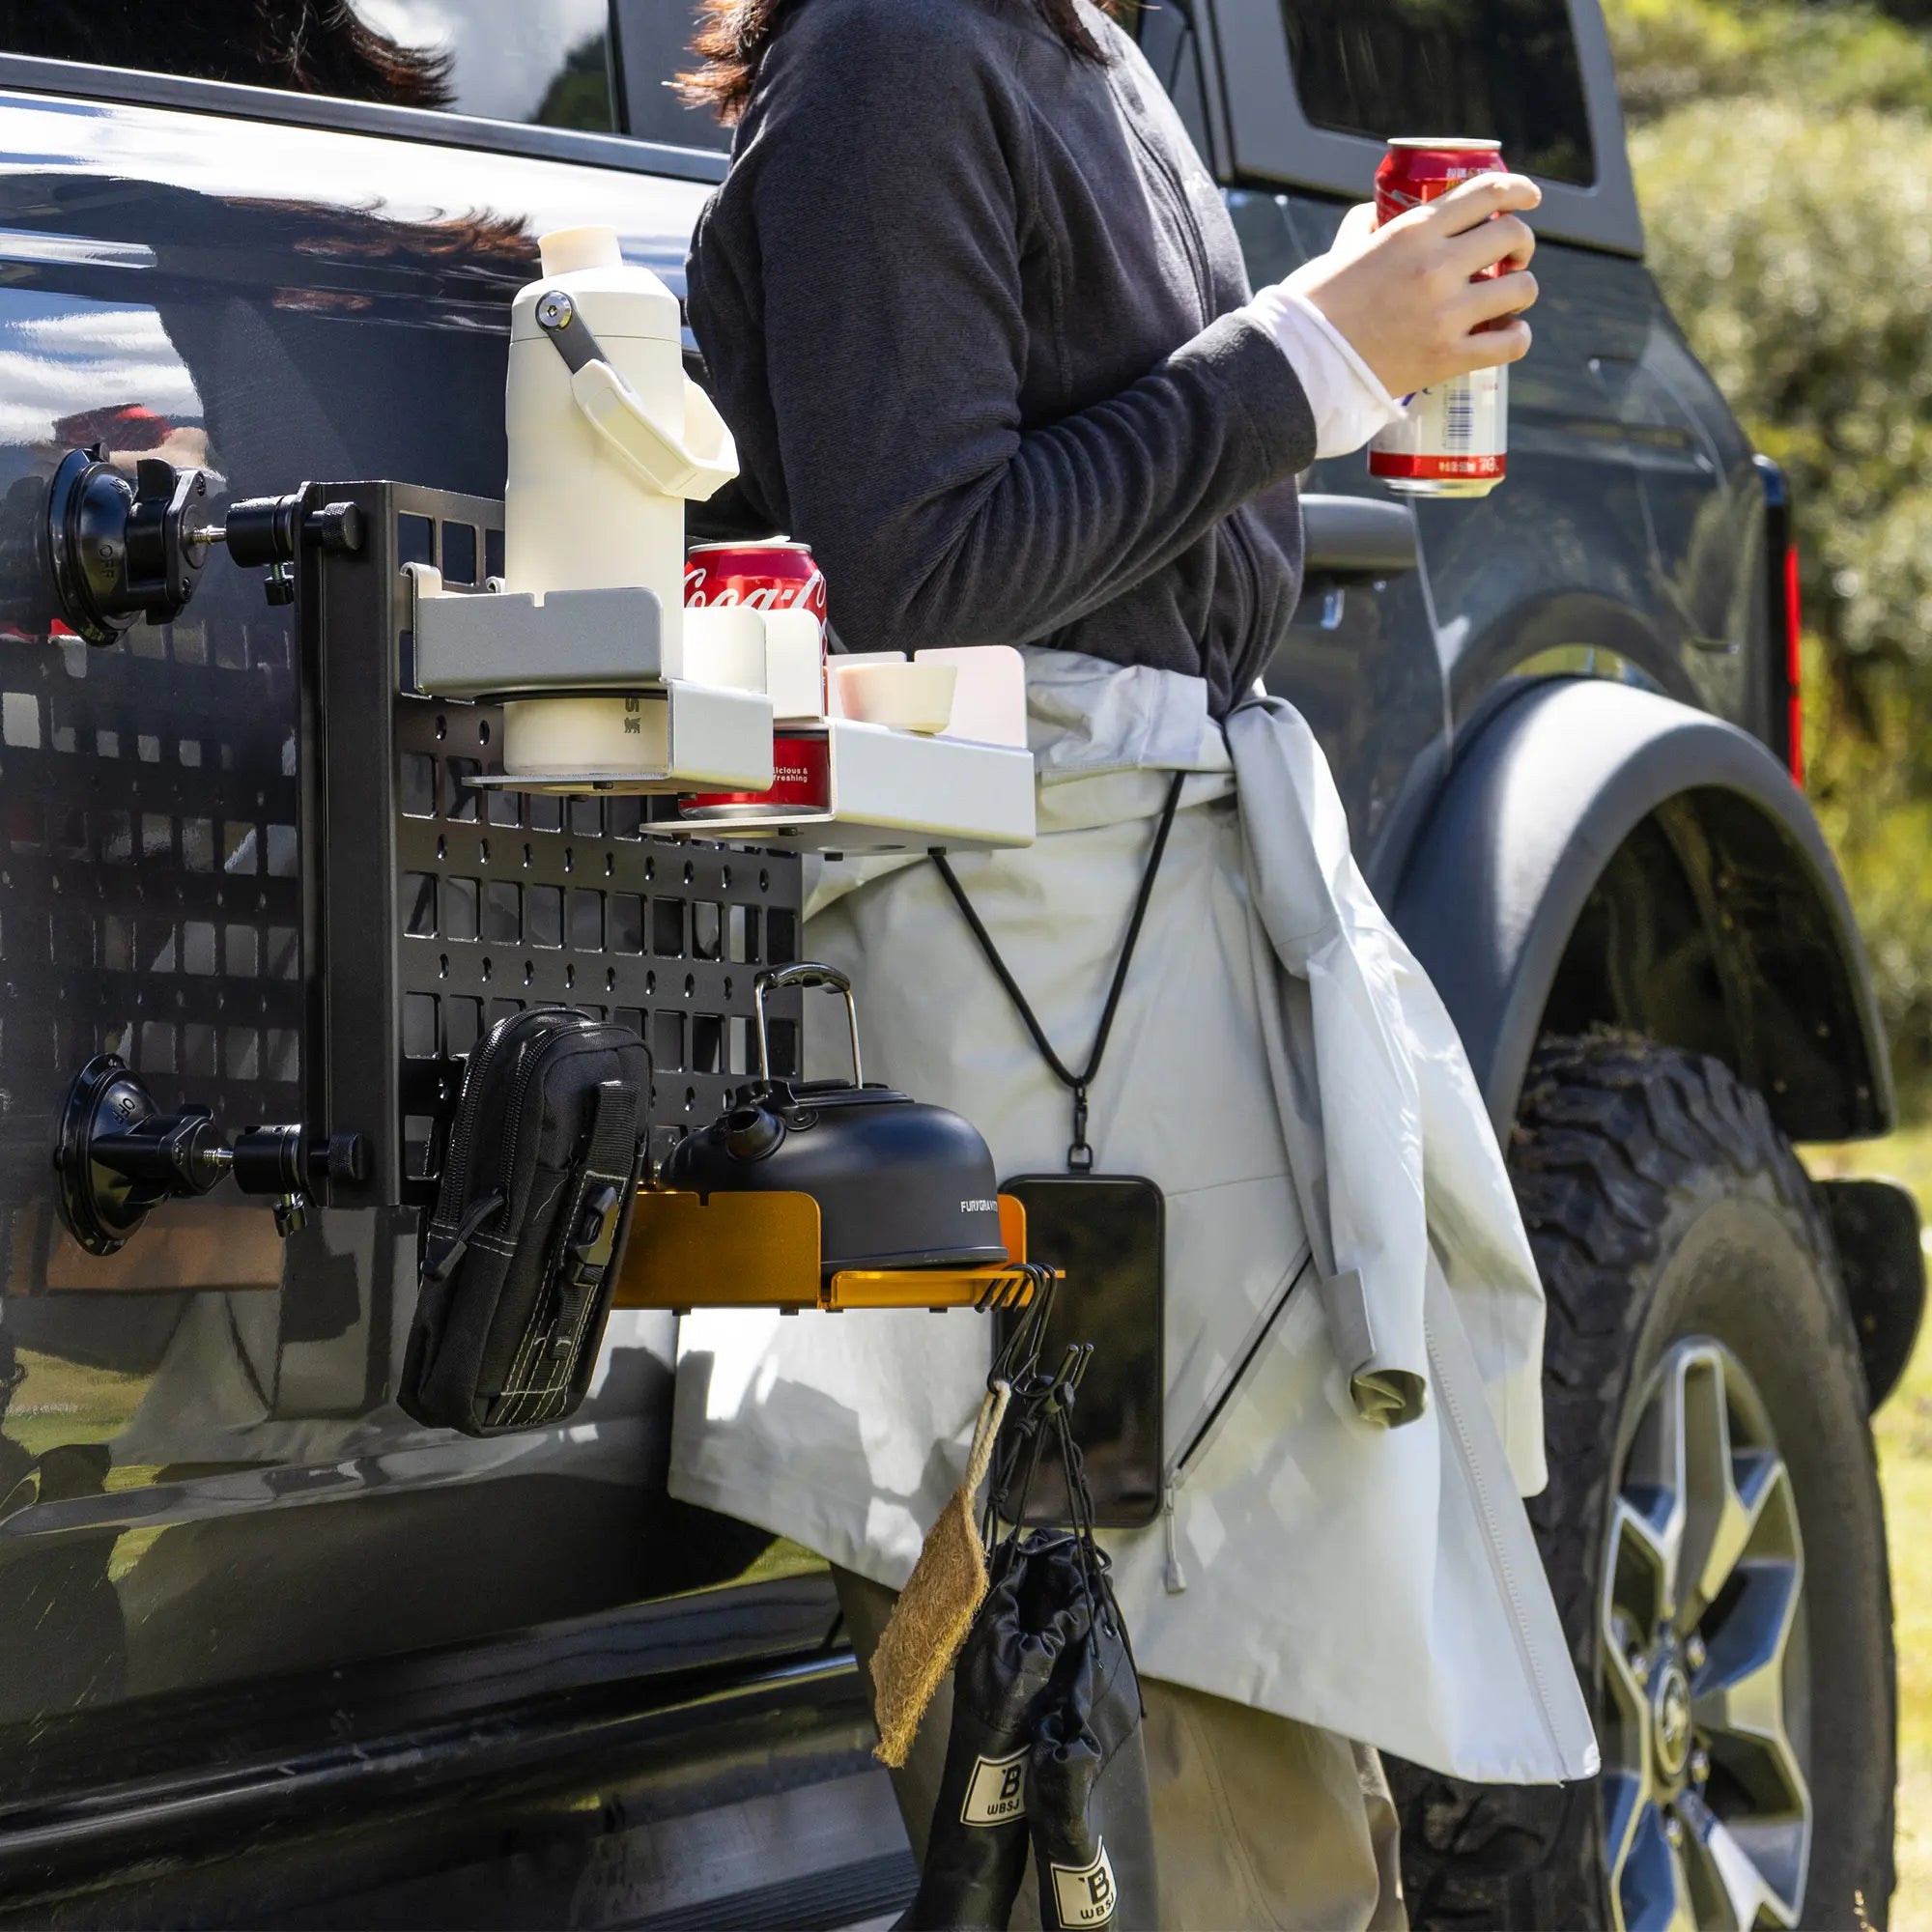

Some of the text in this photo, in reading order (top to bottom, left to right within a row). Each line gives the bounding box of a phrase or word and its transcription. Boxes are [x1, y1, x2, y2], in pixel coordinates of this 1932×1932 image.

[99, 544, 114, 580] OFF
[112, 1097, 135, 1123] OFF
[986, 1798, 1020, 1815] WBSJ
[1080, 1891, 1114, 1919] WBSJ
